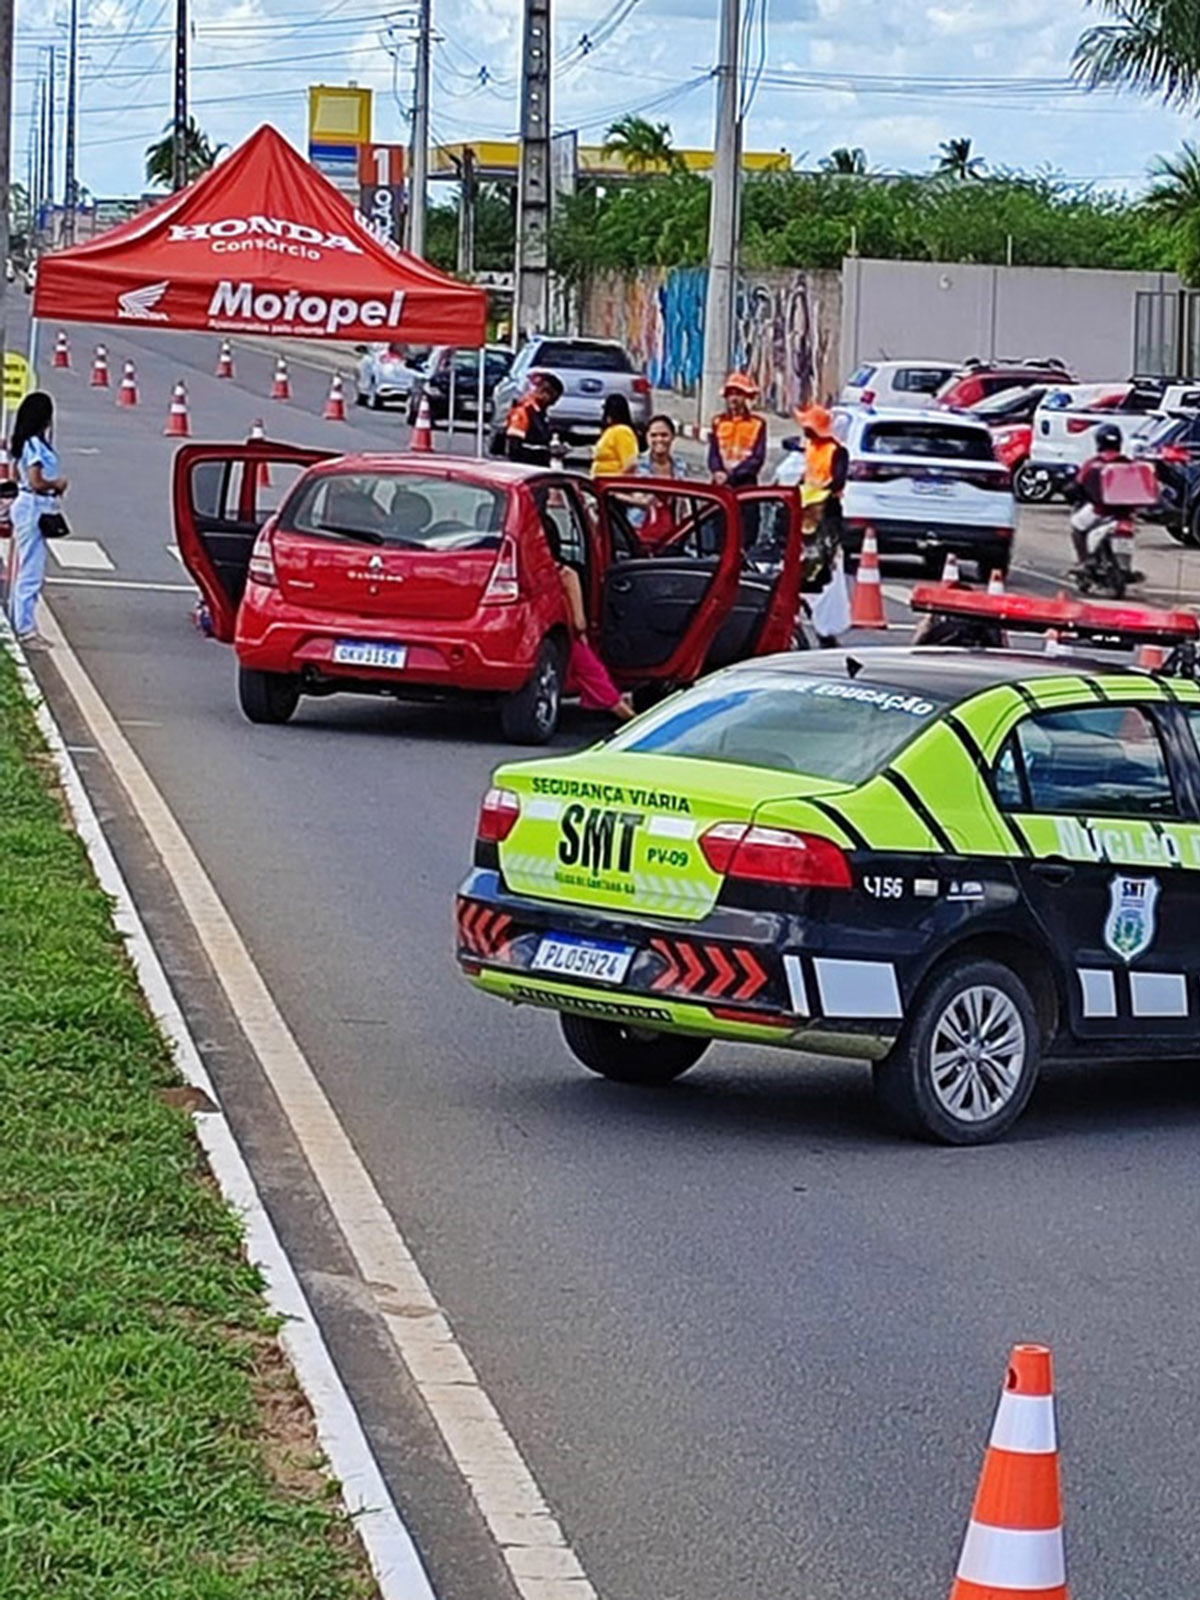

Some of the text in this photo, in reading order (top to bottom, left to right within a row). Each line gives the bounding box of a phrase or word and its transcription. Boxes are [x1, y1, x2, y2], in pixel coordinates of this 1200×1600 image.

[168, 216, 364, 254] HONDA
[211, 237, 321, 260] Consórcio
[208, 281, 405, 333] Motopel
[813, 683, 933, 715] EDUCAÇÃO
[532, 777, 691, 814] SEGURANÇA VIÁRIA
[559, 804, 645, 874] SMT
[646, 847, 689, 867] PV-09
[874, 876, 903, 898] 156
[1122, 881, 1146, 898] SMT
